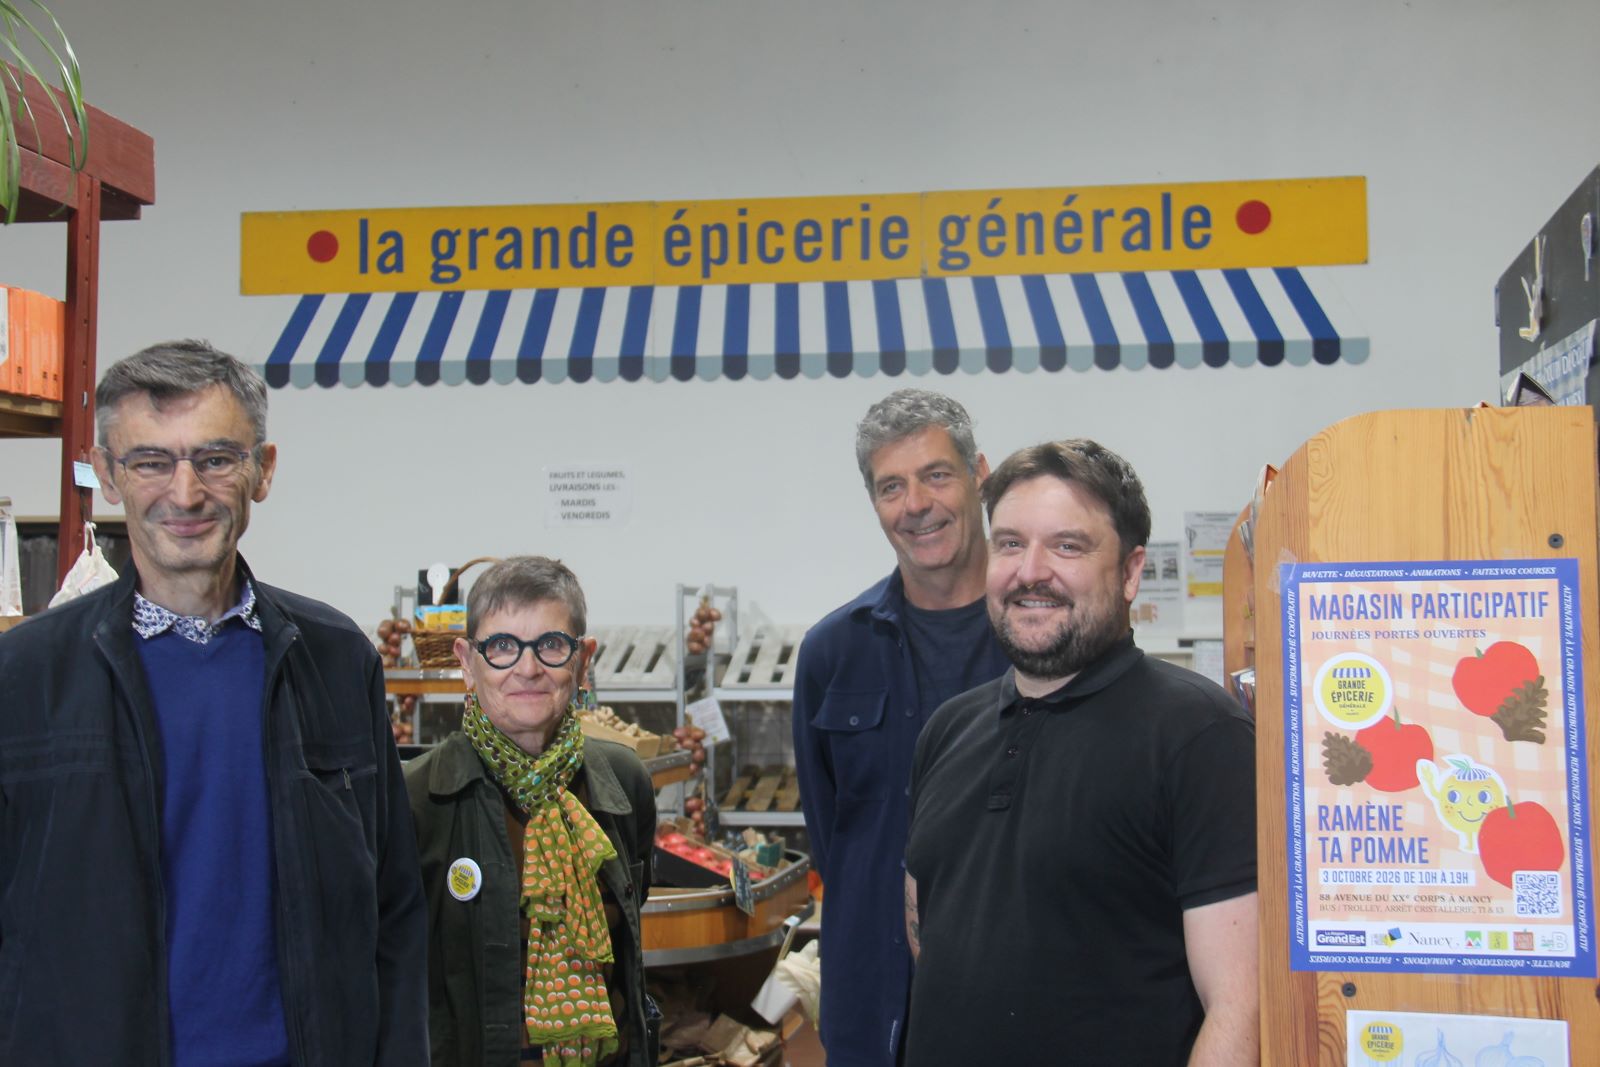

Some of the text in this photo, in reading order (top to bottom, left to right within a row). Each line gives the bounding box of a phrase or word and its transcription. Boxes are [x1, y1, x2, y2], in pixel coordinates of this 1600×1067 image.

[358, 192, 1213, 285] la grande épicerie générale
[549, 471, 575, 479] FRUITS
[576, 471, 585, 479] ET
[549, 483, 601, 492] LIVRAISONS
[560, 498, 596, 507] MARDIS
[560, 511, 610, 520] VENDREDIS
[1302, 566, 1557, 579] BUVETTE DÉGUSTATIONS ANIMATIONS FAITES VOS COURSES
[1286, 588, 1296, 638] COOPÉRATIF
[1309, 591, 1549, 620] MAGASIN PARTICIPATIF
[1563, 584, 1574, 638] ALTERNATIVE
[1311, 628, 1486, 641] JOURNÉES PORTES OUVERTES
[1565, 646, 1575, 657] LA
[1287, 638, 1298, 697] SUPERMARCHÉ
[1566, 658, 1576, 692] GRANDE
[1337, 680, 1366, 689] GRANDE
[1331, 690, 1375, 703] ÉPICERIE
[1567, 692, 1579, 751] DISTRIBUTION
[1292, 781, 1302, 838] DISTRIBUTION
[1317, 800, 1404, 832] RAMÈNE
[1294, 838, 1303, 872] GRANDE
[1317, 836, 1429, 864] TA POMME
[1294, 873, 1304, 884] LA
[1323, 867, 1469, 884] 3 OCTOBRE 2026 DE 10H À 19H
[1574, 837, 1587, 899] SUPERMARCHÉ
[1319, 893, 1330, 901] 88
[1334, 893, 1372, 902] AVENUE
[1375, 893, 1389, 902] DU
[1413, 894, 1446, 903] CORPS
[1458, 895, 1493, 903] NANCY
[1319, 903, 1337, 912] BUS
[1295, 892, 1305, 946] ALTERNATIVE
[1577, 899, 1589, 953] COOPÉRATIF
[1309, 955, 1571, 968] BUVETTE DÉGUSTATIONS ANIMATIONS FAITES VOS COURSES
